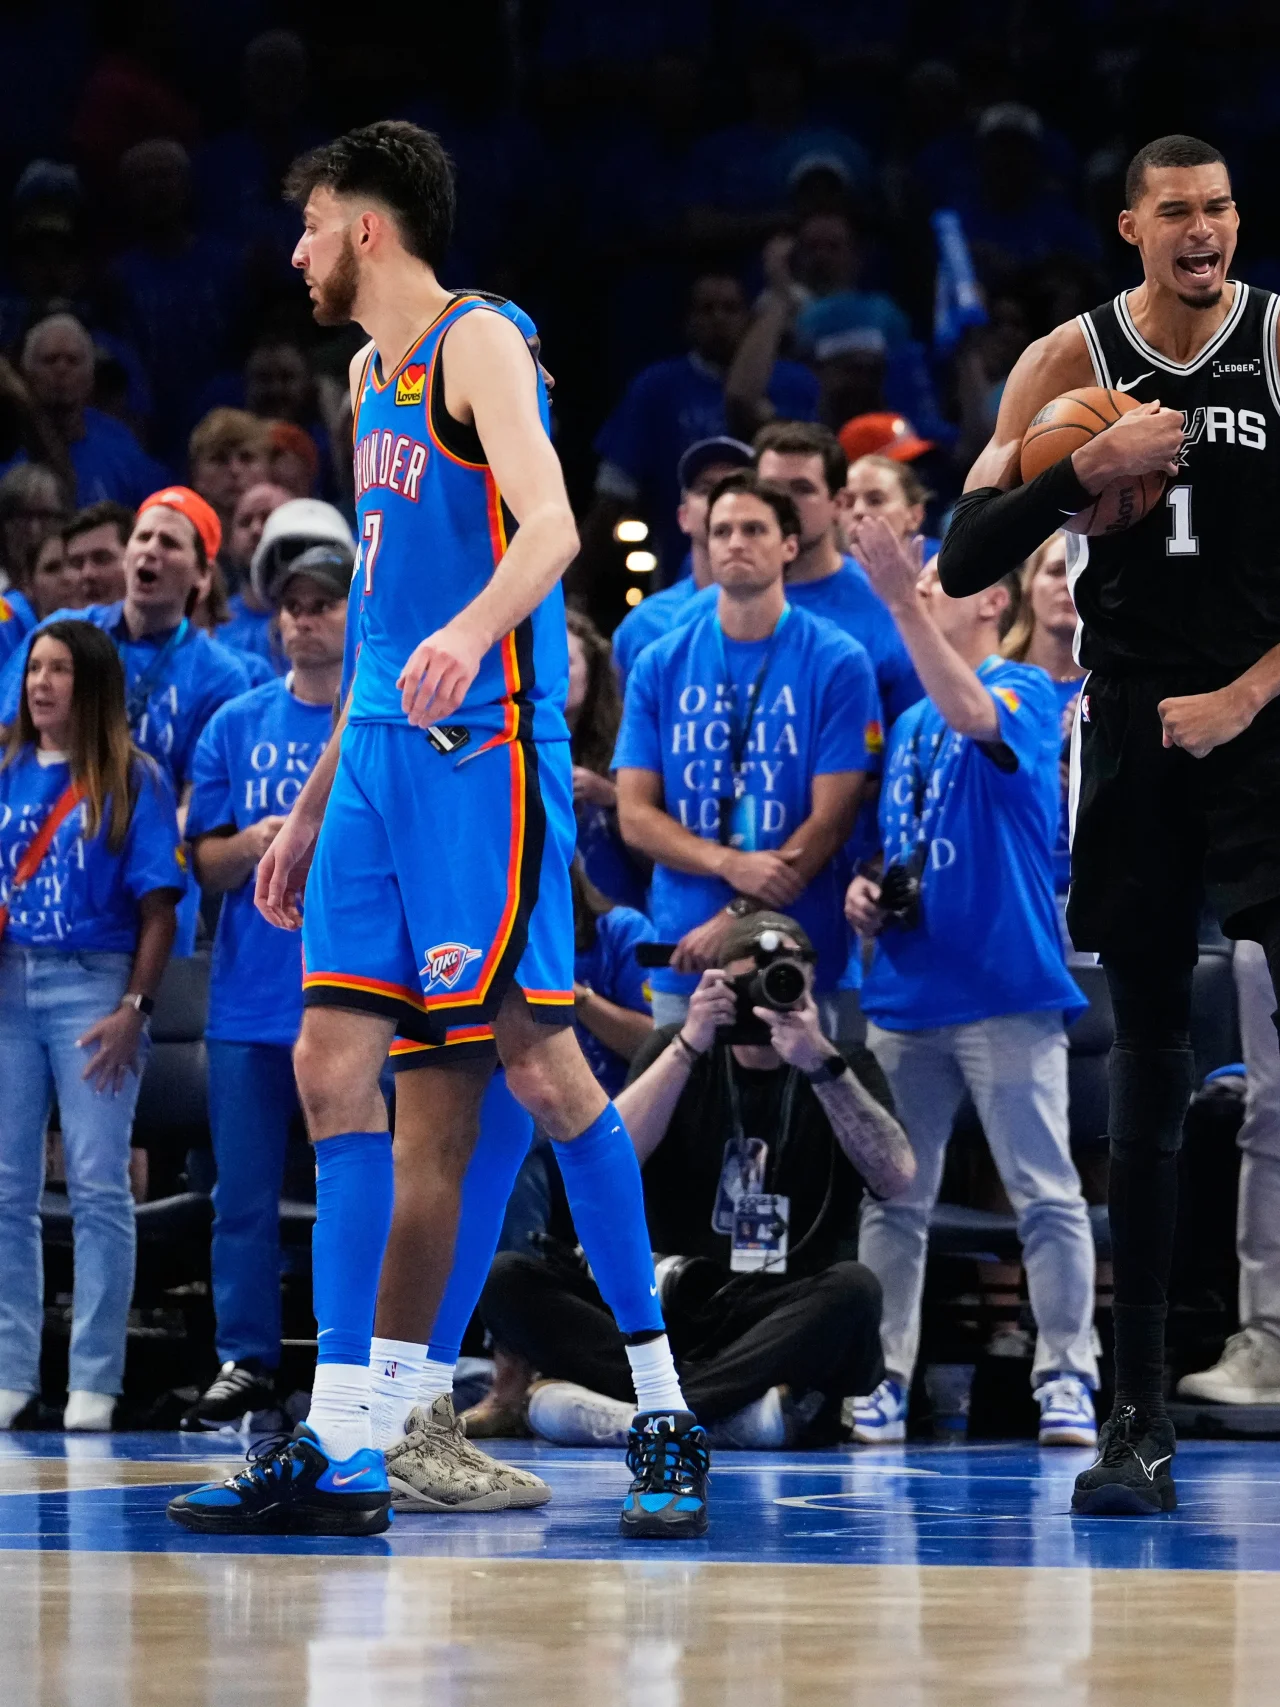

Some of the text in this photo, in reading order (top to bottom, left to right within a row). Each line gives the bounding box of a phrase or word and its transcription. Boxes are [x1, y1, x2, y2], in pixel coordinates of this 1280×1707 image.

[1218, 363, 1255, 373] LEDGER
[353, 429, 429, 503] HUNDER
[1166, 485, 1200, 556] 1
[363, 510, 383, 596] 7
[679, 798, 786, 832] LOD
[431, 950, 460, 979] OKC
